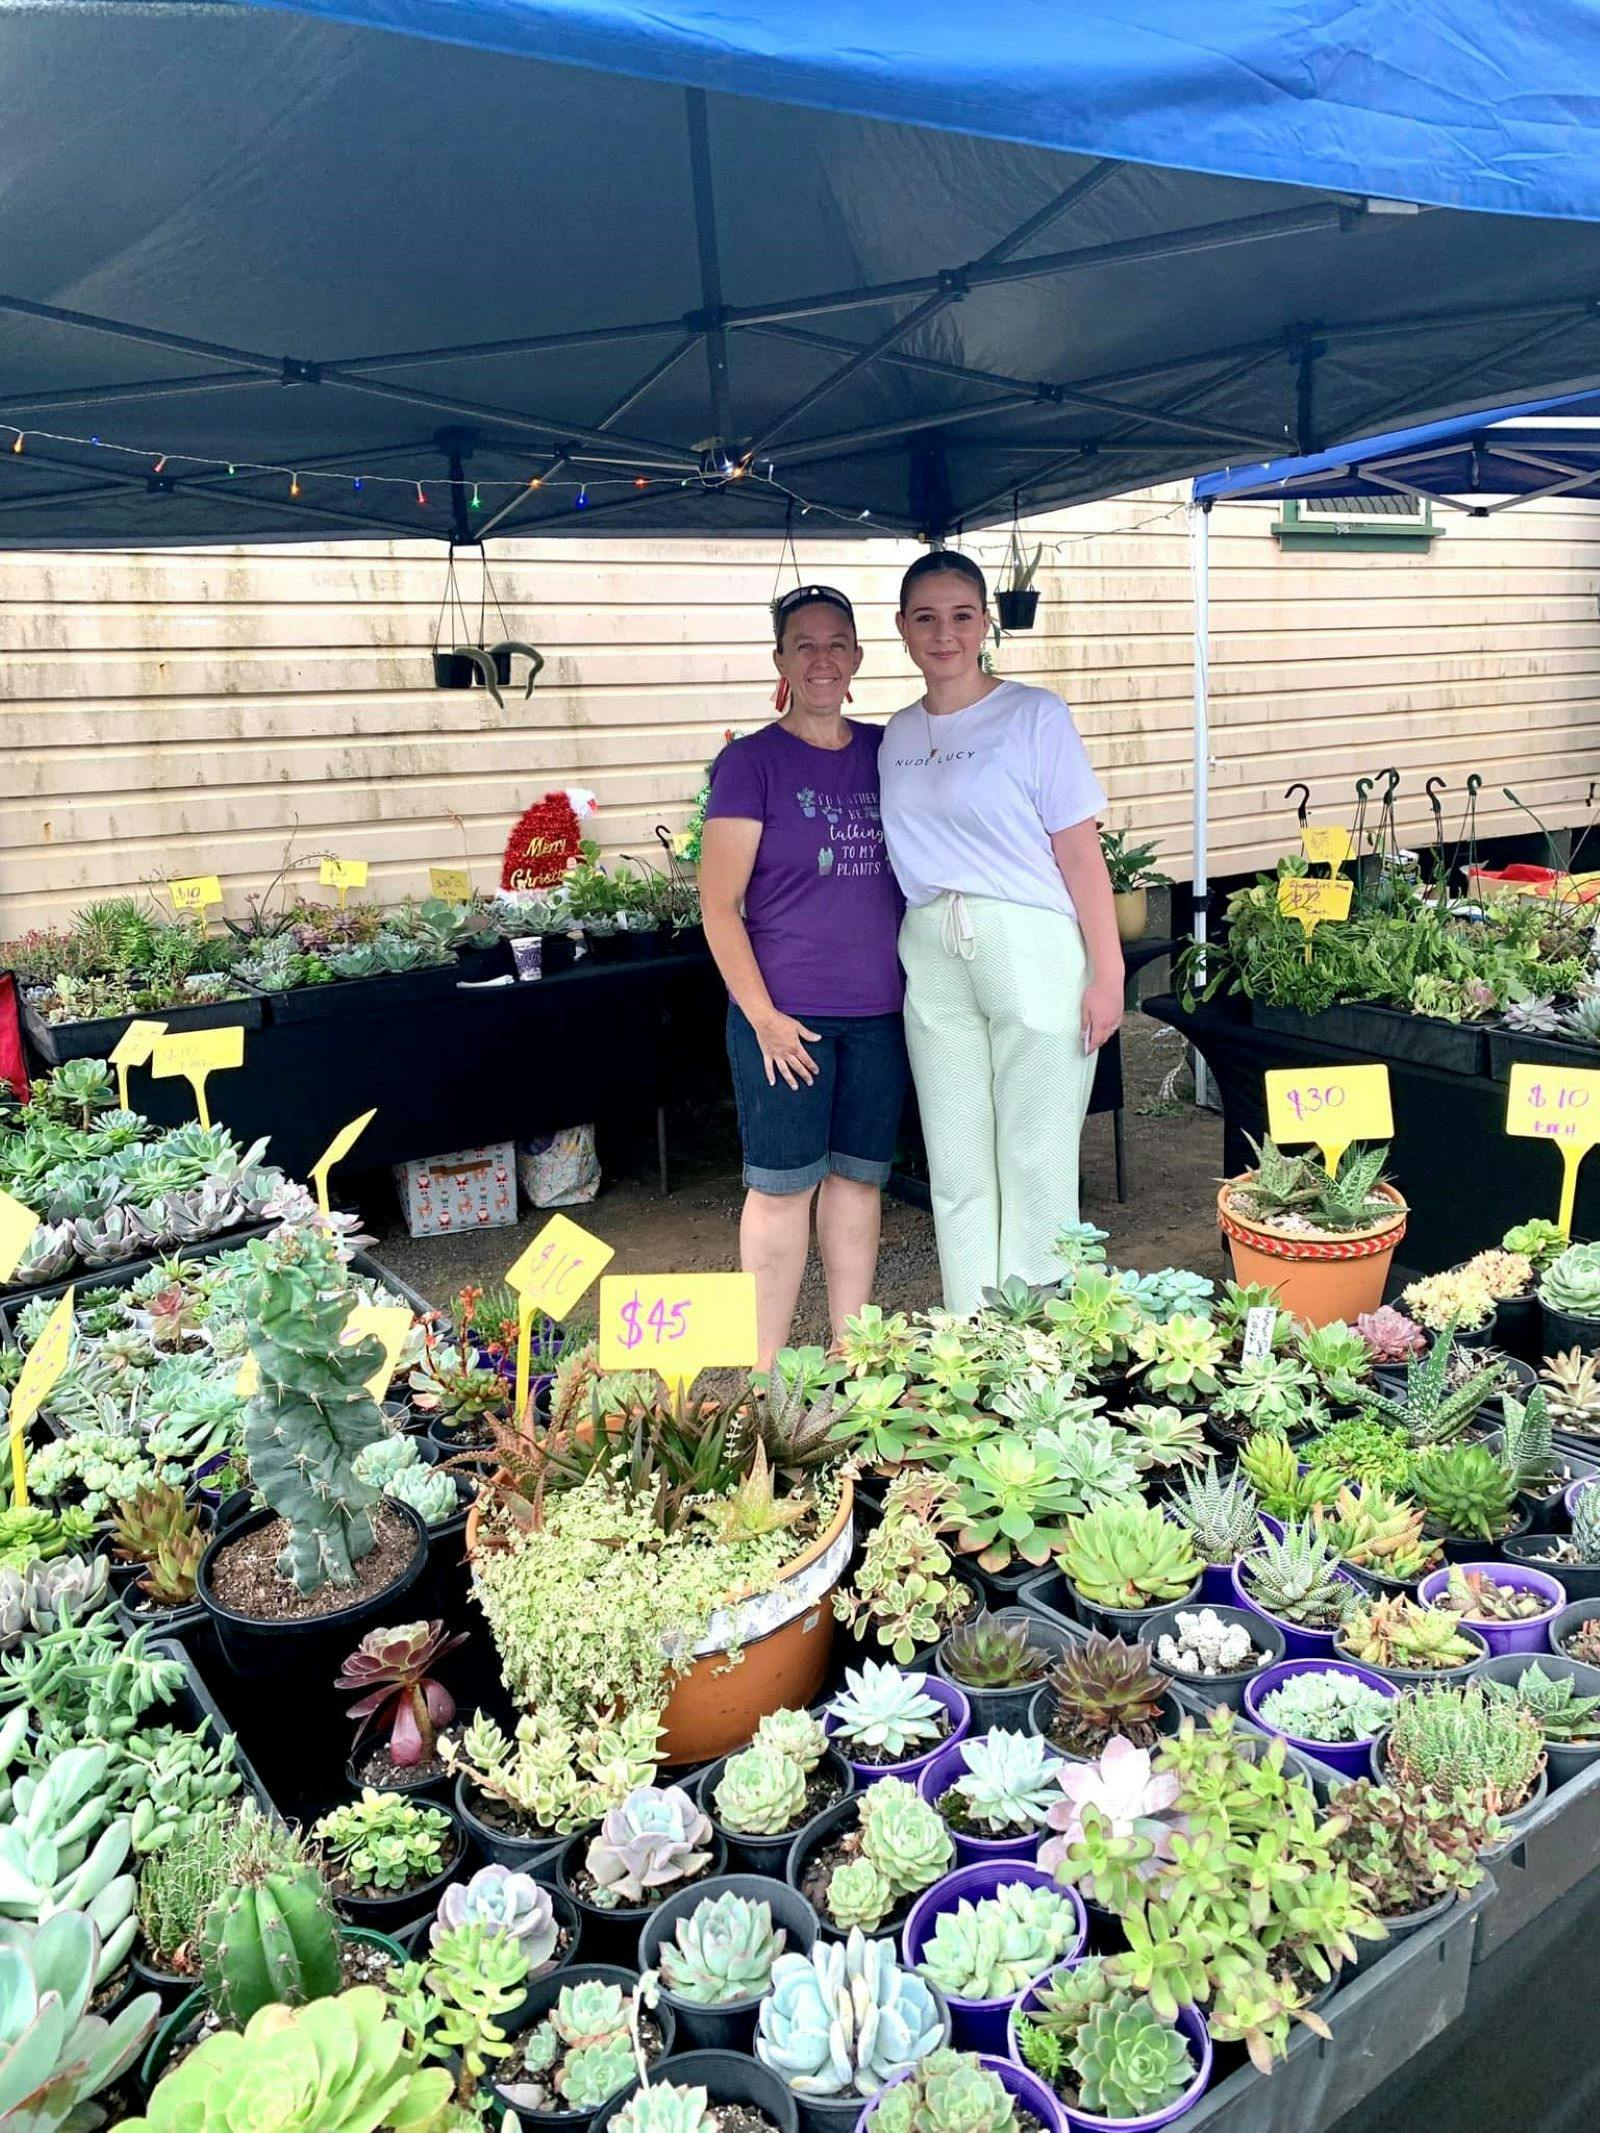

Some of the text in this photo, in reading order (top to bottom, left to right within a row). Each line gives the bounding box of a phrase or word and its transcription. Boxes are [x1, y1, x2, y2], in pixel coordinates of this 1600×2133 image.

[895, 750, 976, 767] NUDE LUCY
[830, 823, 884, 843] talking
[522, 837, 567, 857] Merry
[842, 844, 877, 859] TO MY
[510, 868, 565, 889] Christ
[836, 861, 881, 877] PLANTS
[1287, 1085, 1345, 1121] $30
[1528, 1084, 1589, 1109] $10
[617, 1289, 692, 1349] $45
